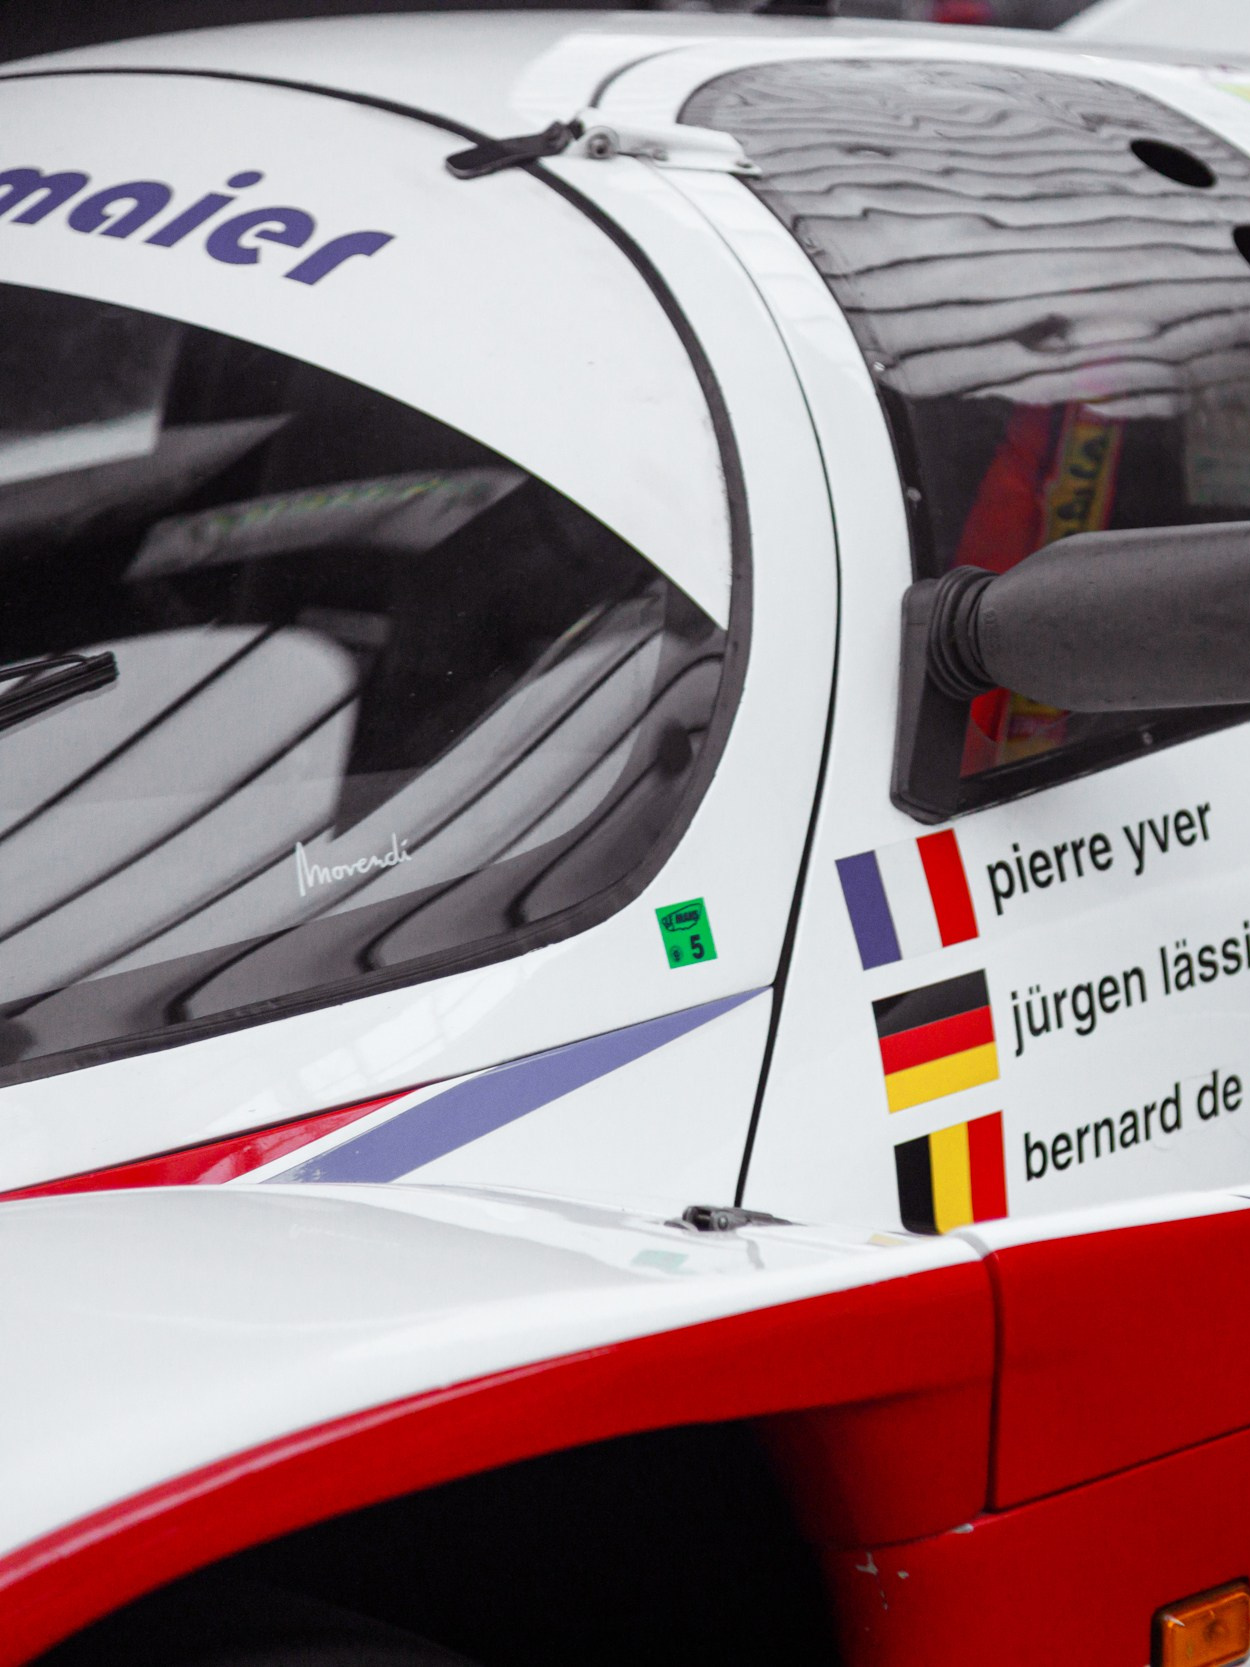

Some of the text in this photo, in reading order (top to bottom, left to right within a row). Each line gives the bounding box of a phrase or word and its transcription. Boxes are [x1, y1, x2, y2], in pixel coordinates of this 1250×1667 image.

[986, 801, 1212, 916] pierre yver
[690, 934, 705, 959] 5
[1011, 965, 1147, 1057] jürgen
[1024, 1082, 1182, 1182] bernard
[1196, 1069, 1242, 1121] de
